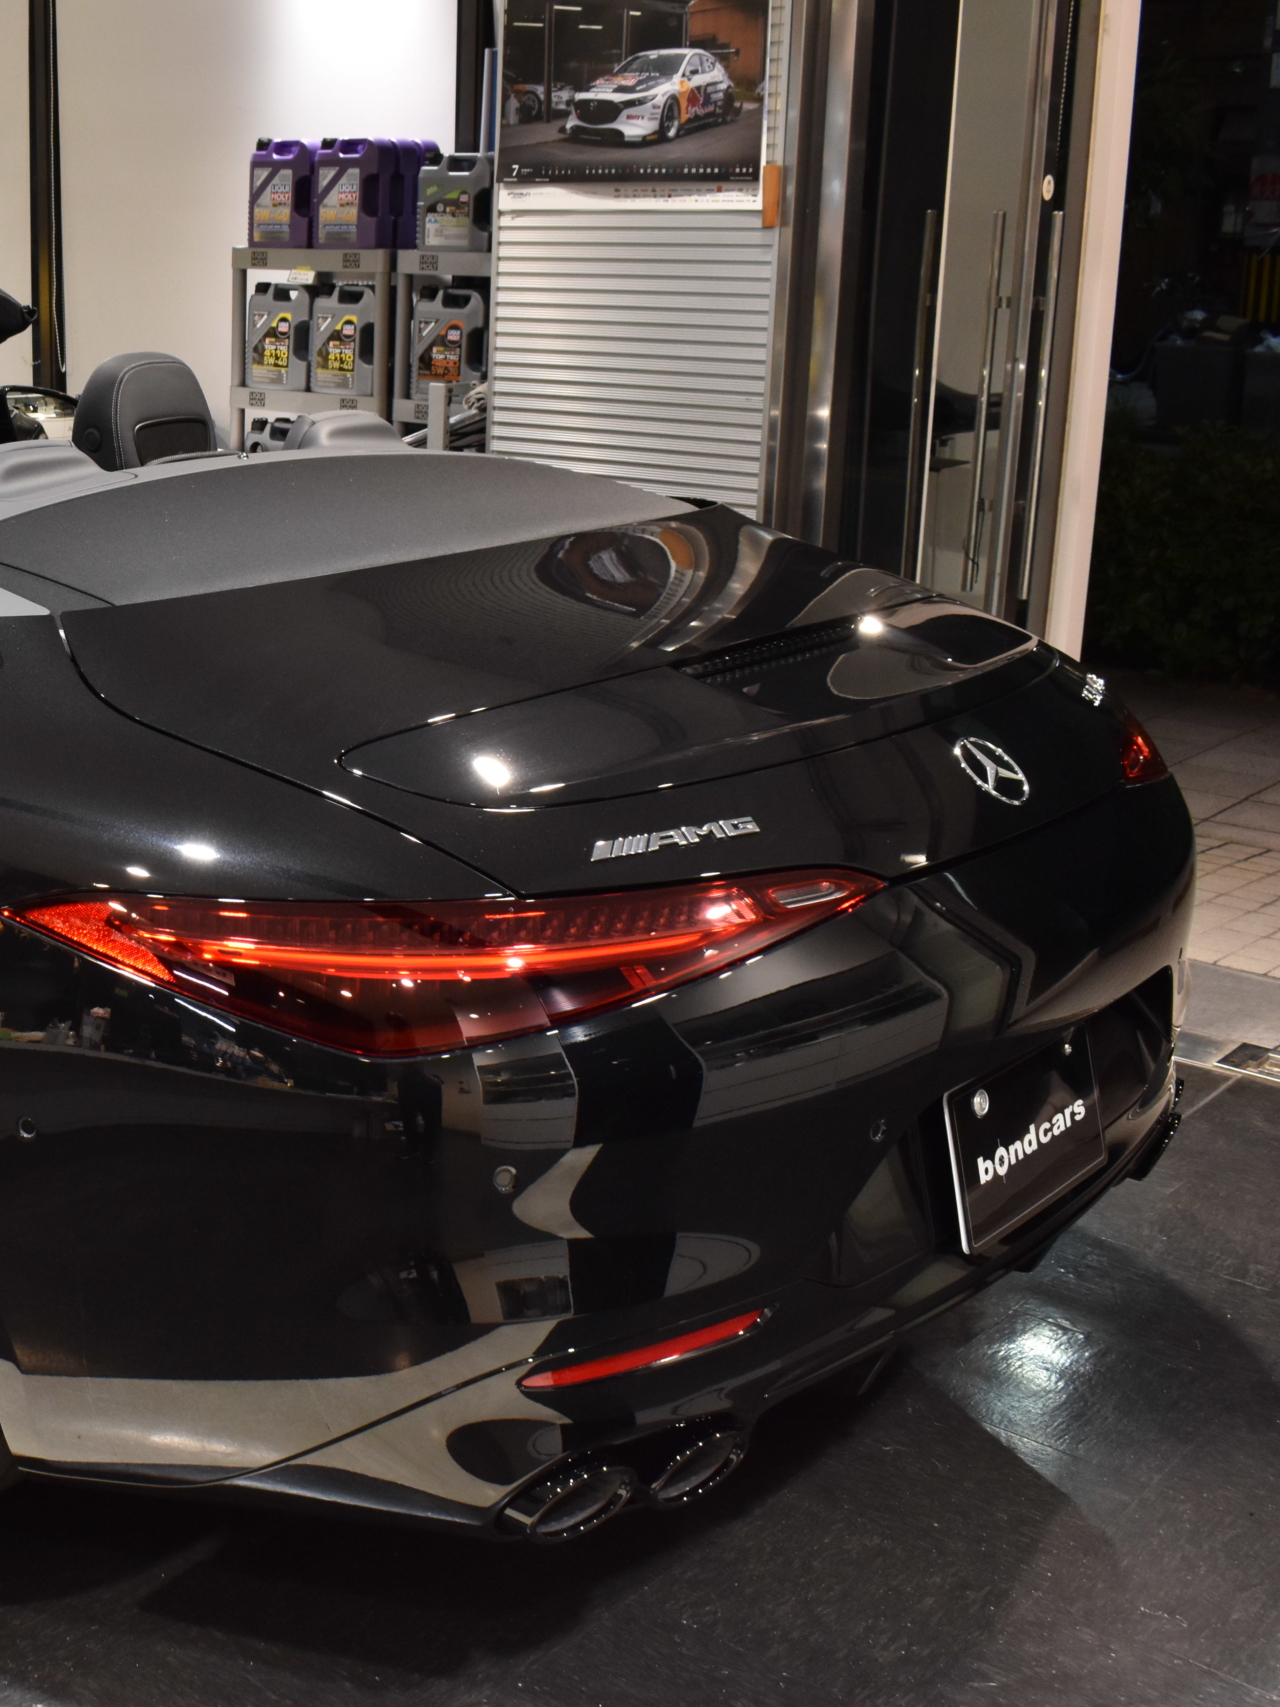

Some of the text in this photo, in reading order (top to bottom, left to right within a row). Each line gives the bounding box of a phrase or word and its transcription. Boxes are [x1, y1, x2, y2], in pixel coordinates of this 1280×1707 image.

[511, 164, 519, 177] 7
[271, 184, 290, 192] LIQUI
[339, 183, 358, 192] LIQUI
[271, 193, 290, 201] MOLY
[339, 193, 358, 201] MOLY
[255, 210, 290, 222] 5W-40
[321, 210, 357, 222] 5W-40
[264, 350, 288, 358] 4110
[329, 353, 353, 361] 4110
[264, 356, 287, 366] 5W-40
[329, 360, 353, 370] 5W-40
